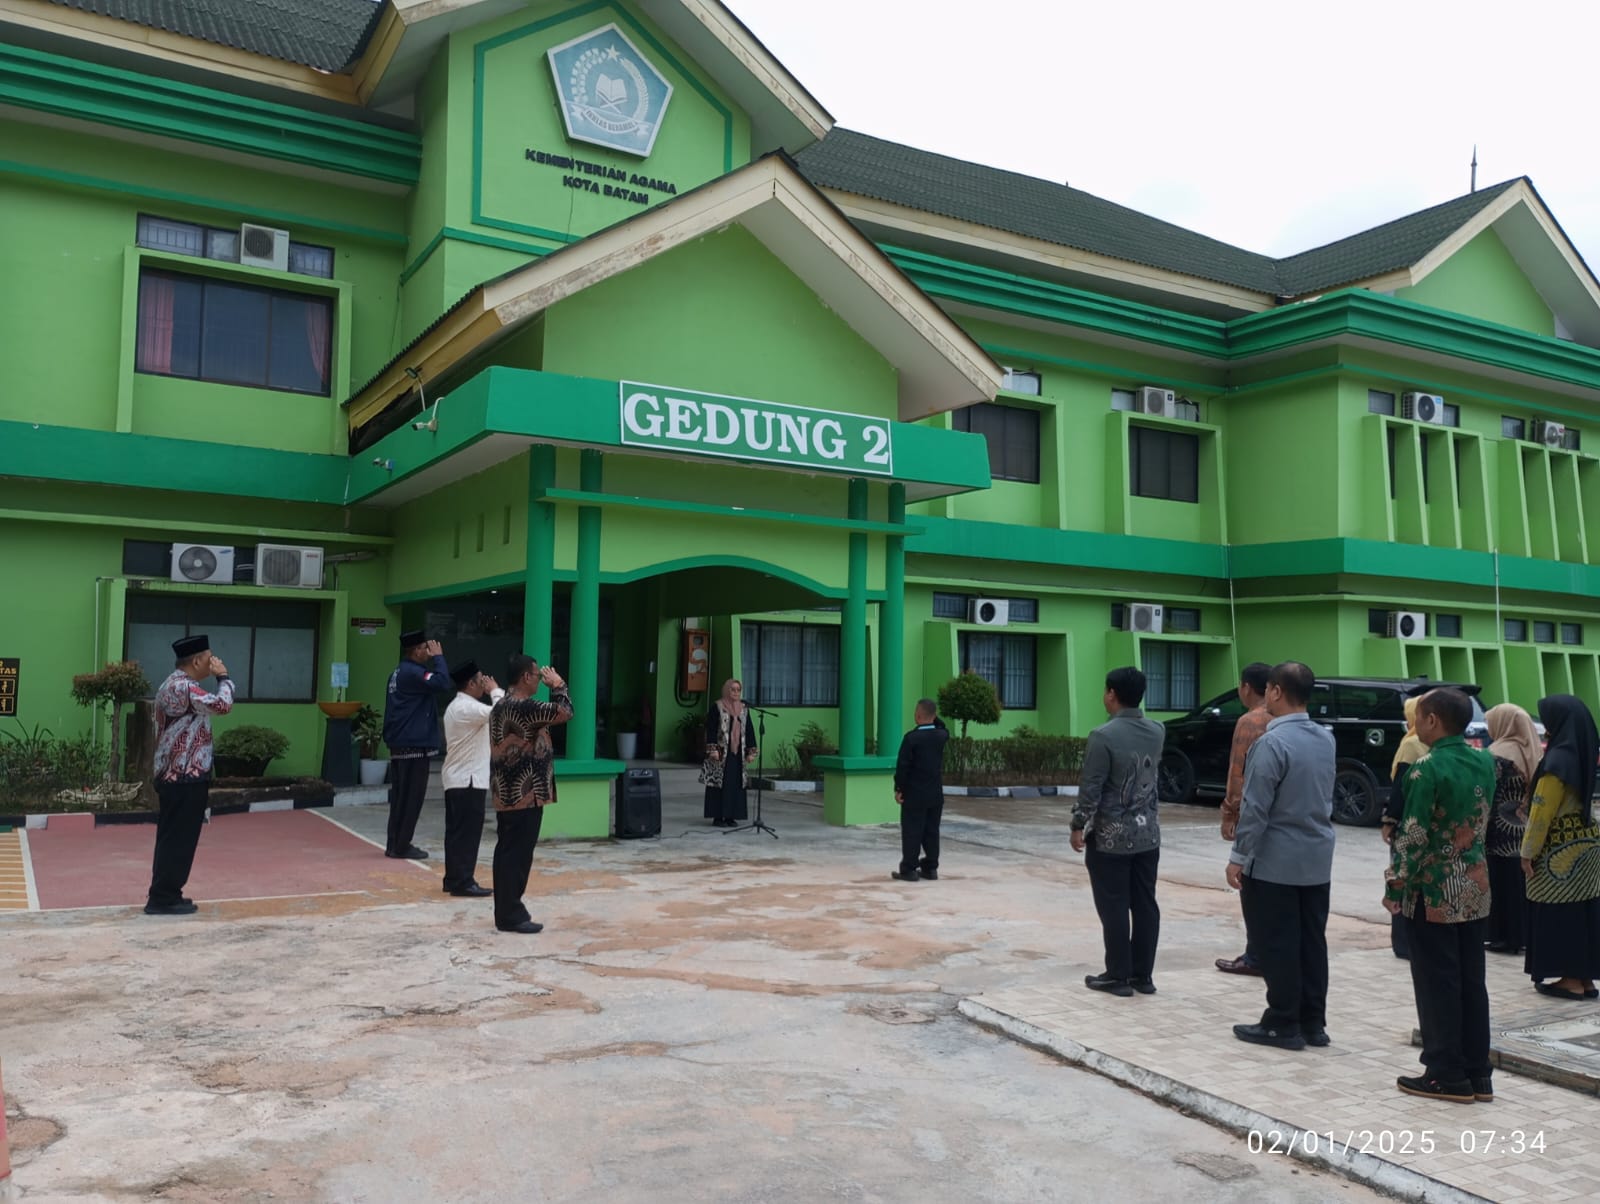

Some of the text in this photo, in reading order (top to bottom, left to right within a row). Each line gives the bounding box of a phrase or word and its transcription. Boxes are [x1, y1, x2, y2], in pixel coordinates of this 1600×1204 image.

[525, 149, 677, 195] KEMENTERIAN AGAMA
[562, 175, 649, 205] KOTA BATAM
[624, 393, 889, 465] GEDUNG 2
